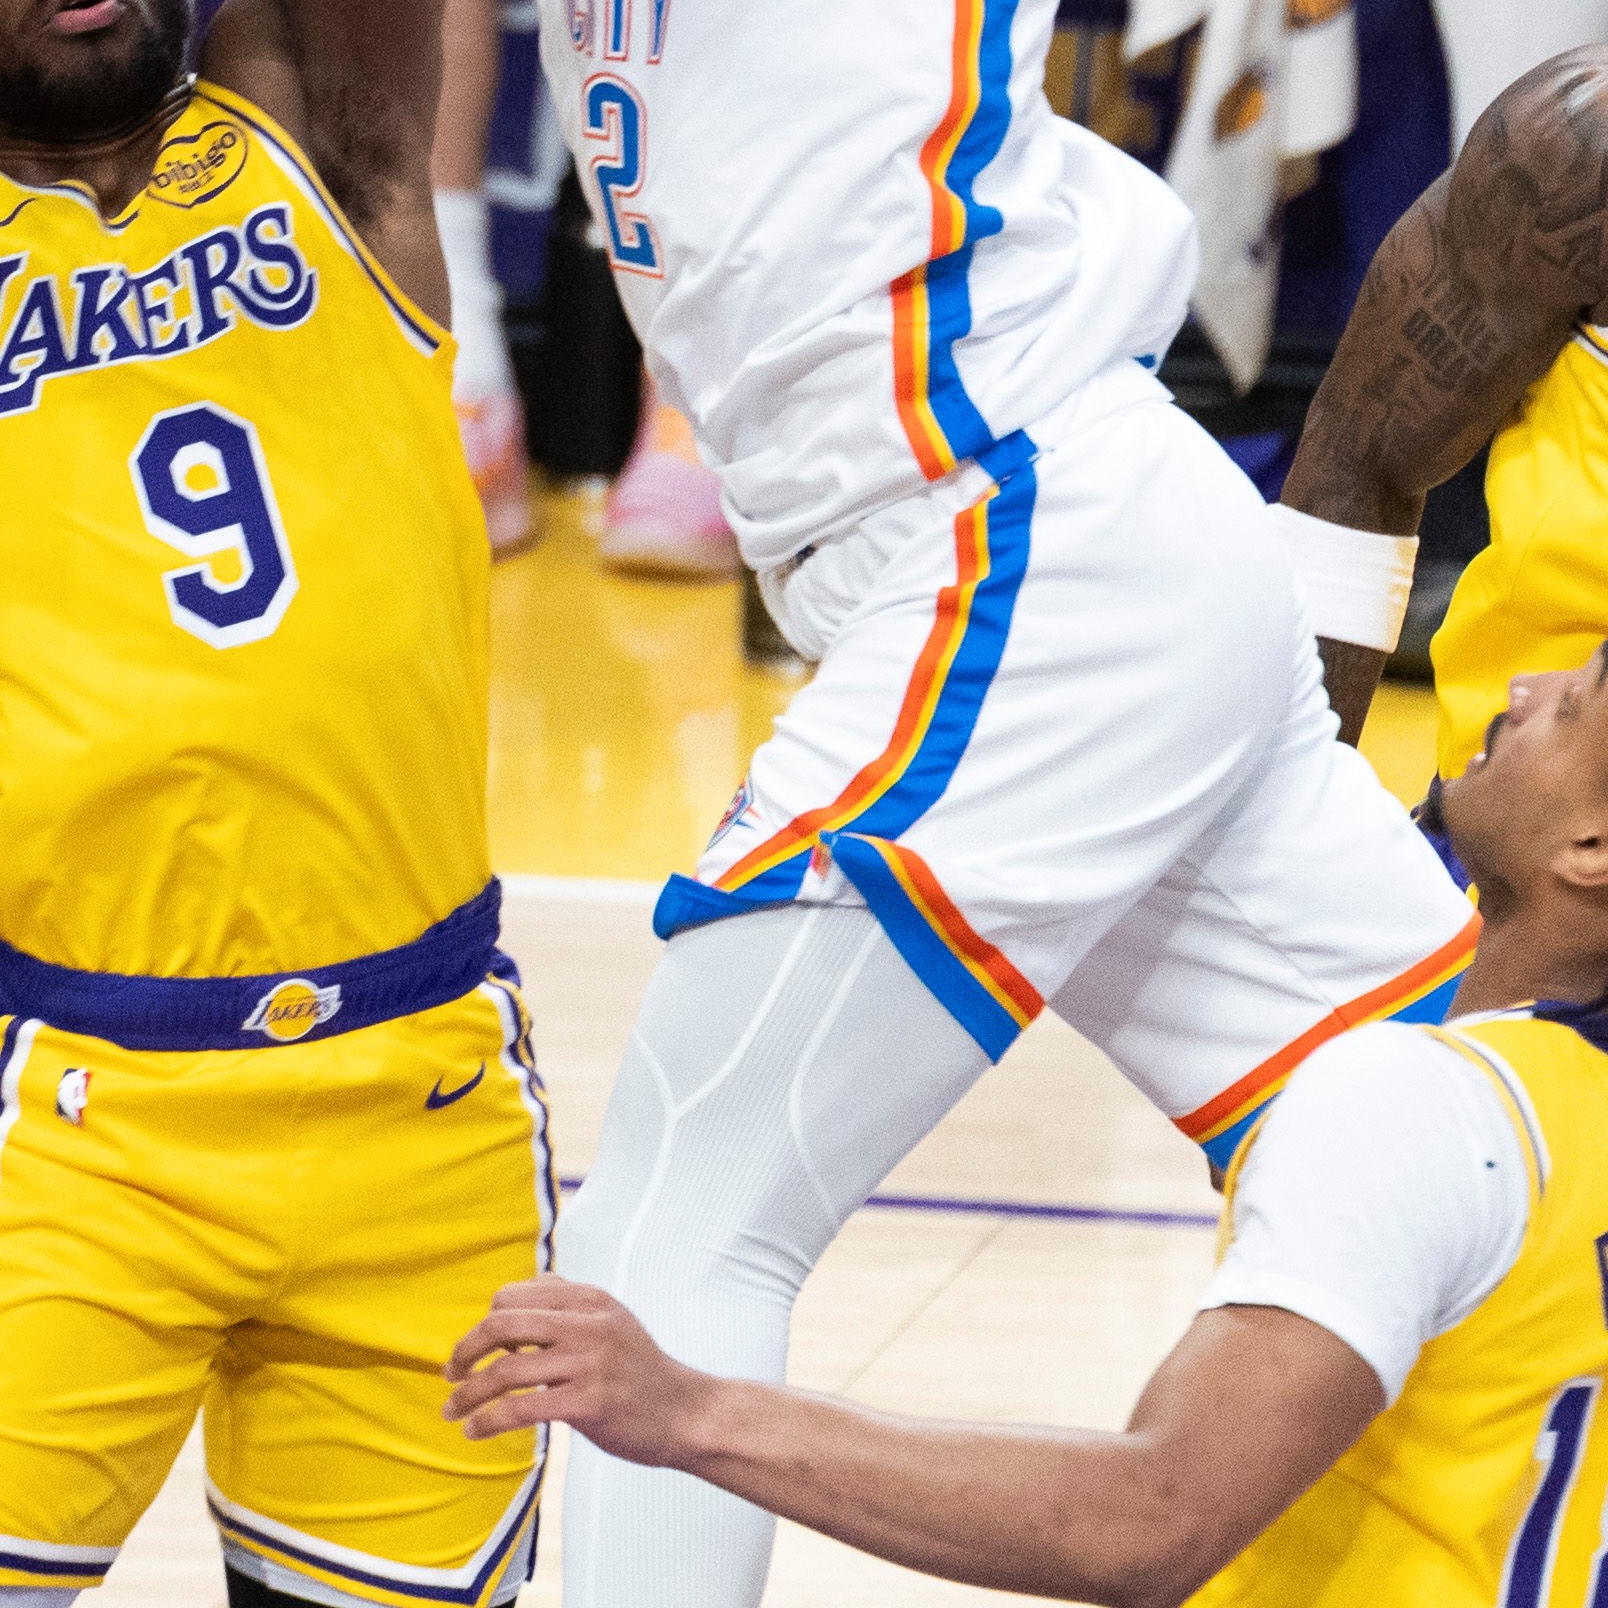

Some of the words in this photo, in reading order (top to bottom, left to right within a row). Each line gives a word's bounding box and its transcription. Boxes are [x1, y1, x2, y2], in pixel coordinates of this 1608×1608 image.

[152, 130, 237, 189] bibigo
[581, 71, 665, 279] 2
[128, 399, 299, 651] 9
